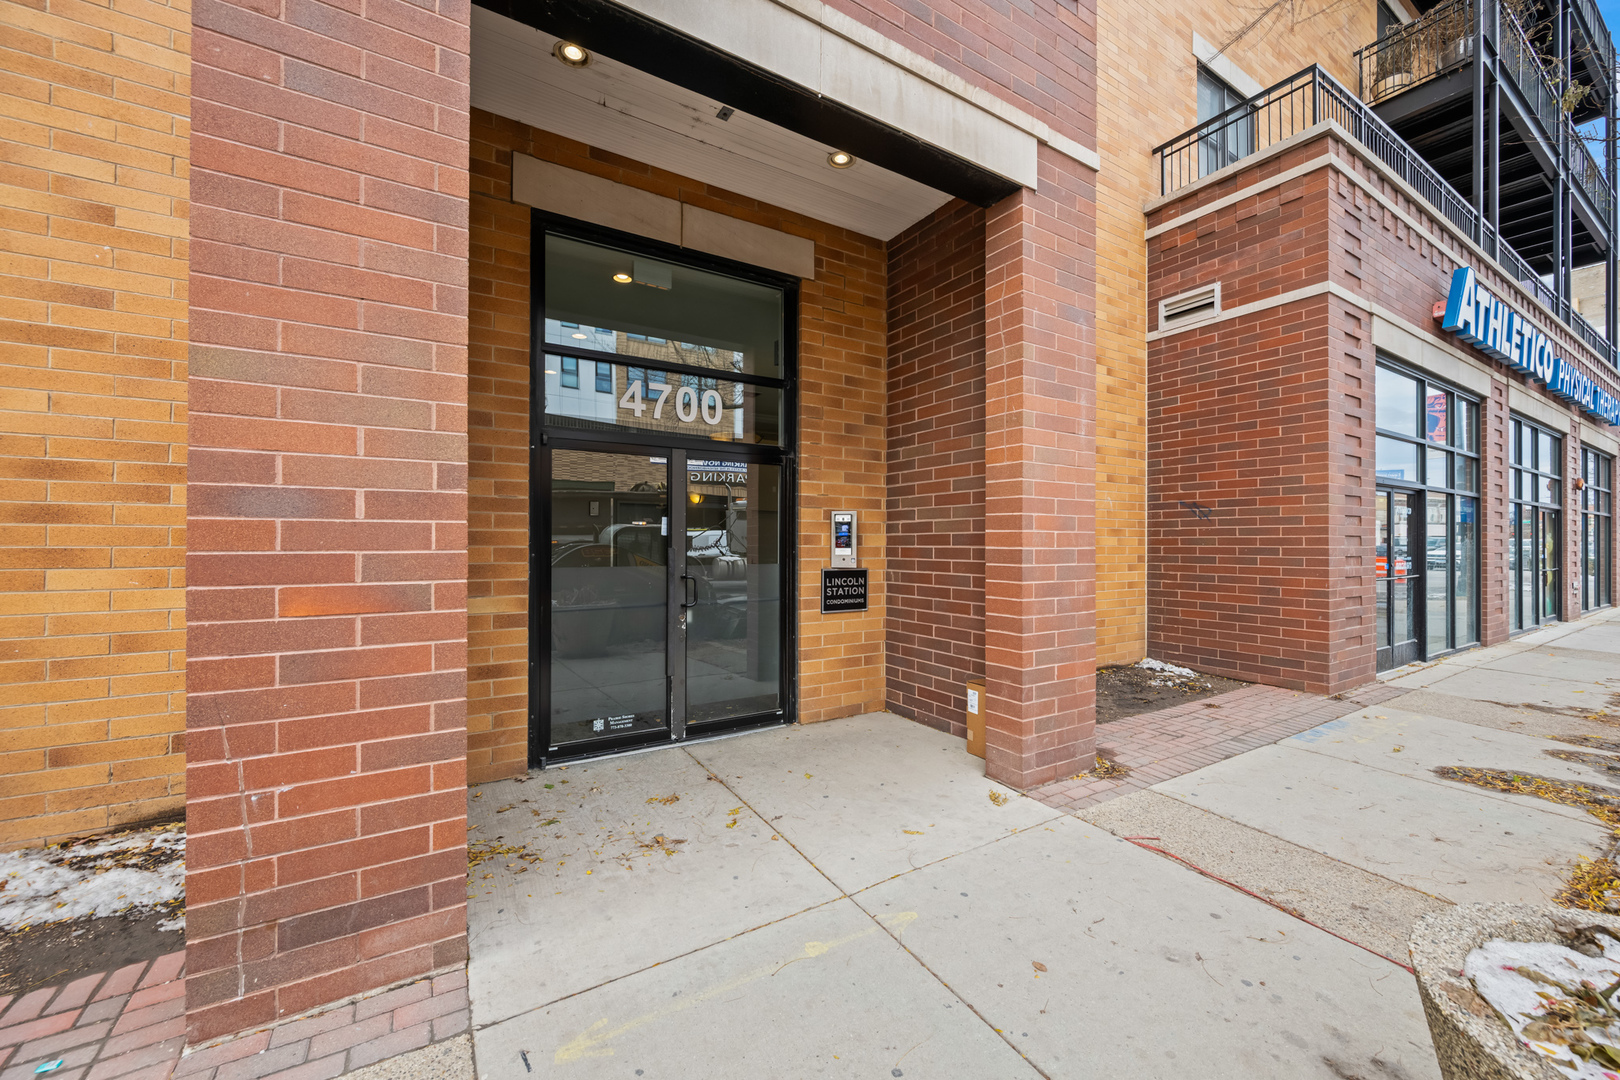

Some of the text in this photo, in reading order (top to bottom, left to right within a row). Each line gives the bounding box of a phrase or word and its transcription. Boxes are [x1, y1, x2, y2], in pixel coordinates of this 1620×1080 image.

[1456, 266, 1554, 384] ATHLETICO
[1558, 359, 1595, 410] PHYSICAL
[619, 380, 723, 425] 4700
[826, 577, 865, 586] LINCOLN
[826, 586, 865, 596] STATION
[826, 597, 865, 605] CONDOMINIUMS
